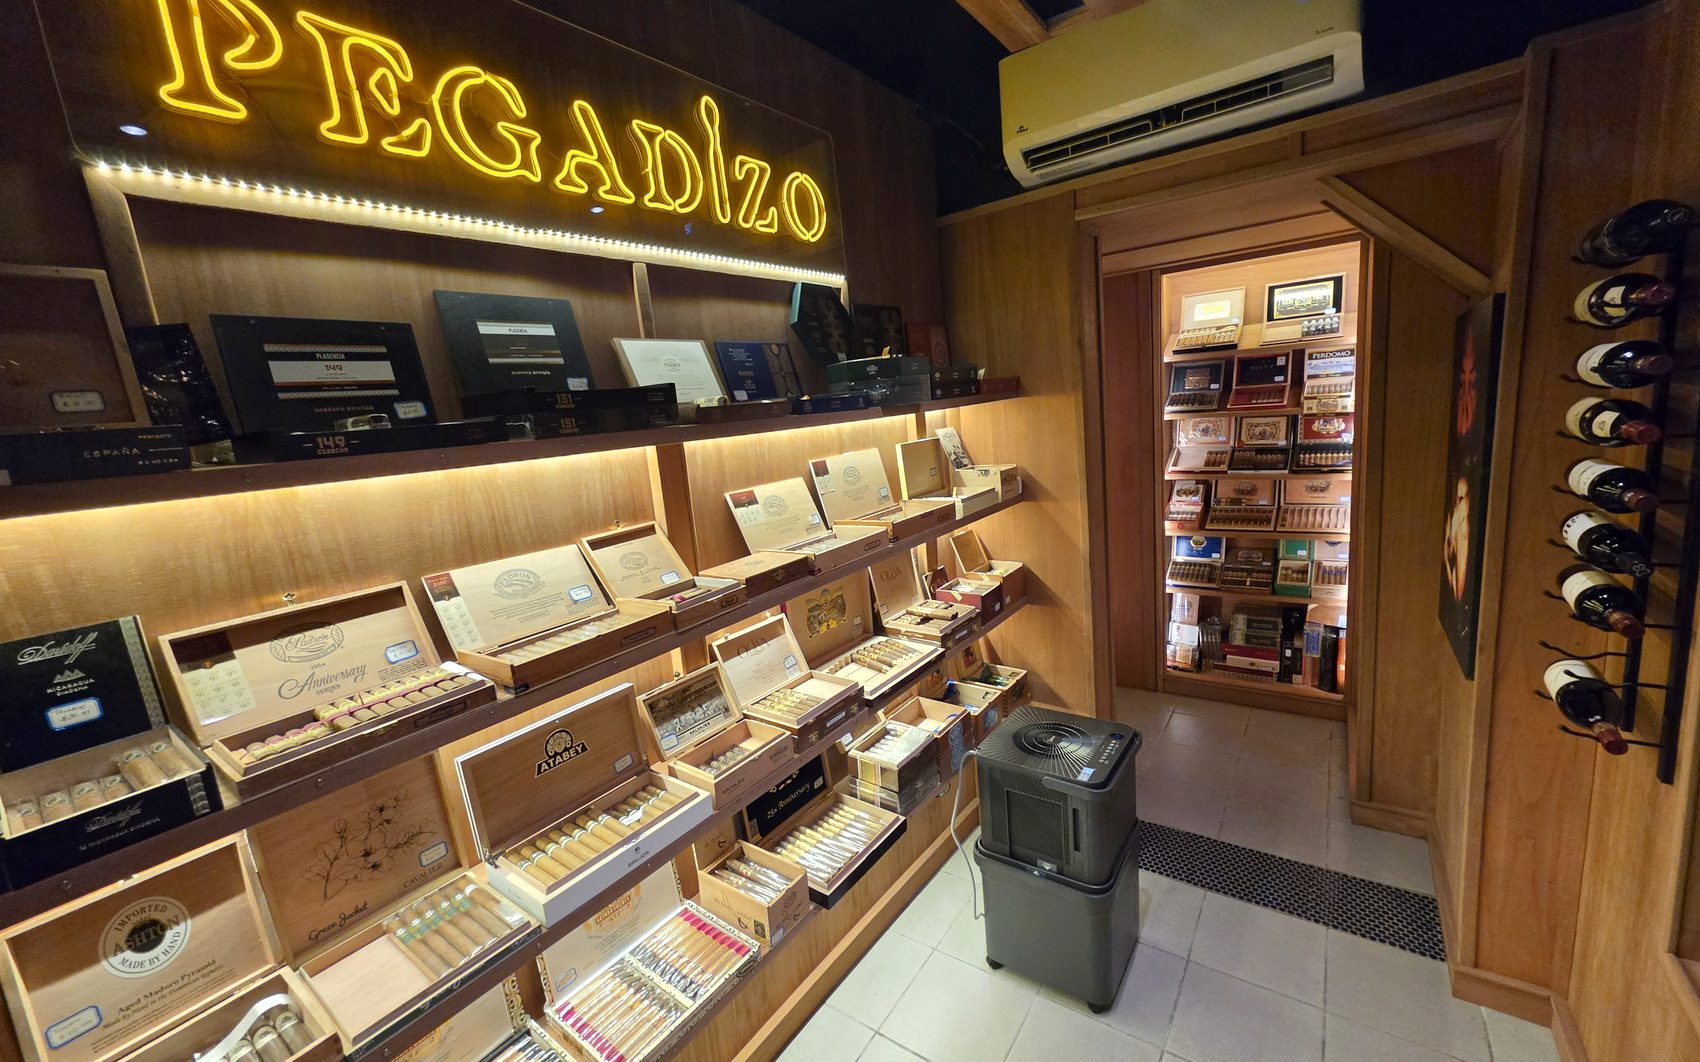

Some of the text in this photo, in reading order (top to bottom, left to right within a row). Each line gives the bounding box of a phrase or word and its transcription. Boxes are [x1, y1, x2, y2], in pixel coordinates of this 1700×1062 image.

[324, 364, 343, 372] 149
[1312, 350, 1351, 359] PERDOMO
[556, 393, 573, 404] 151
[316, 435, 346, 448] 149
[17, 631, 98, 665] Davidoff
[46, 678, 95, 694] NICARAGUA
[278, 664, 368, 699] Anniversary
[540, 744, 583, 772] ATABEY
[777, 782, 811, 810] Anniversary
[403, 862, 442, 888] CAVALIER
[115, 904, 168, 931] IMPORTED
[308, 900, 368, 941] Green Jacket
[112, 914, 181, 957] ASHTON
[118, 931, 181, 969] MADE BY HAND
[117, 959, 217, 1014] Aged Maduro Pyramid
